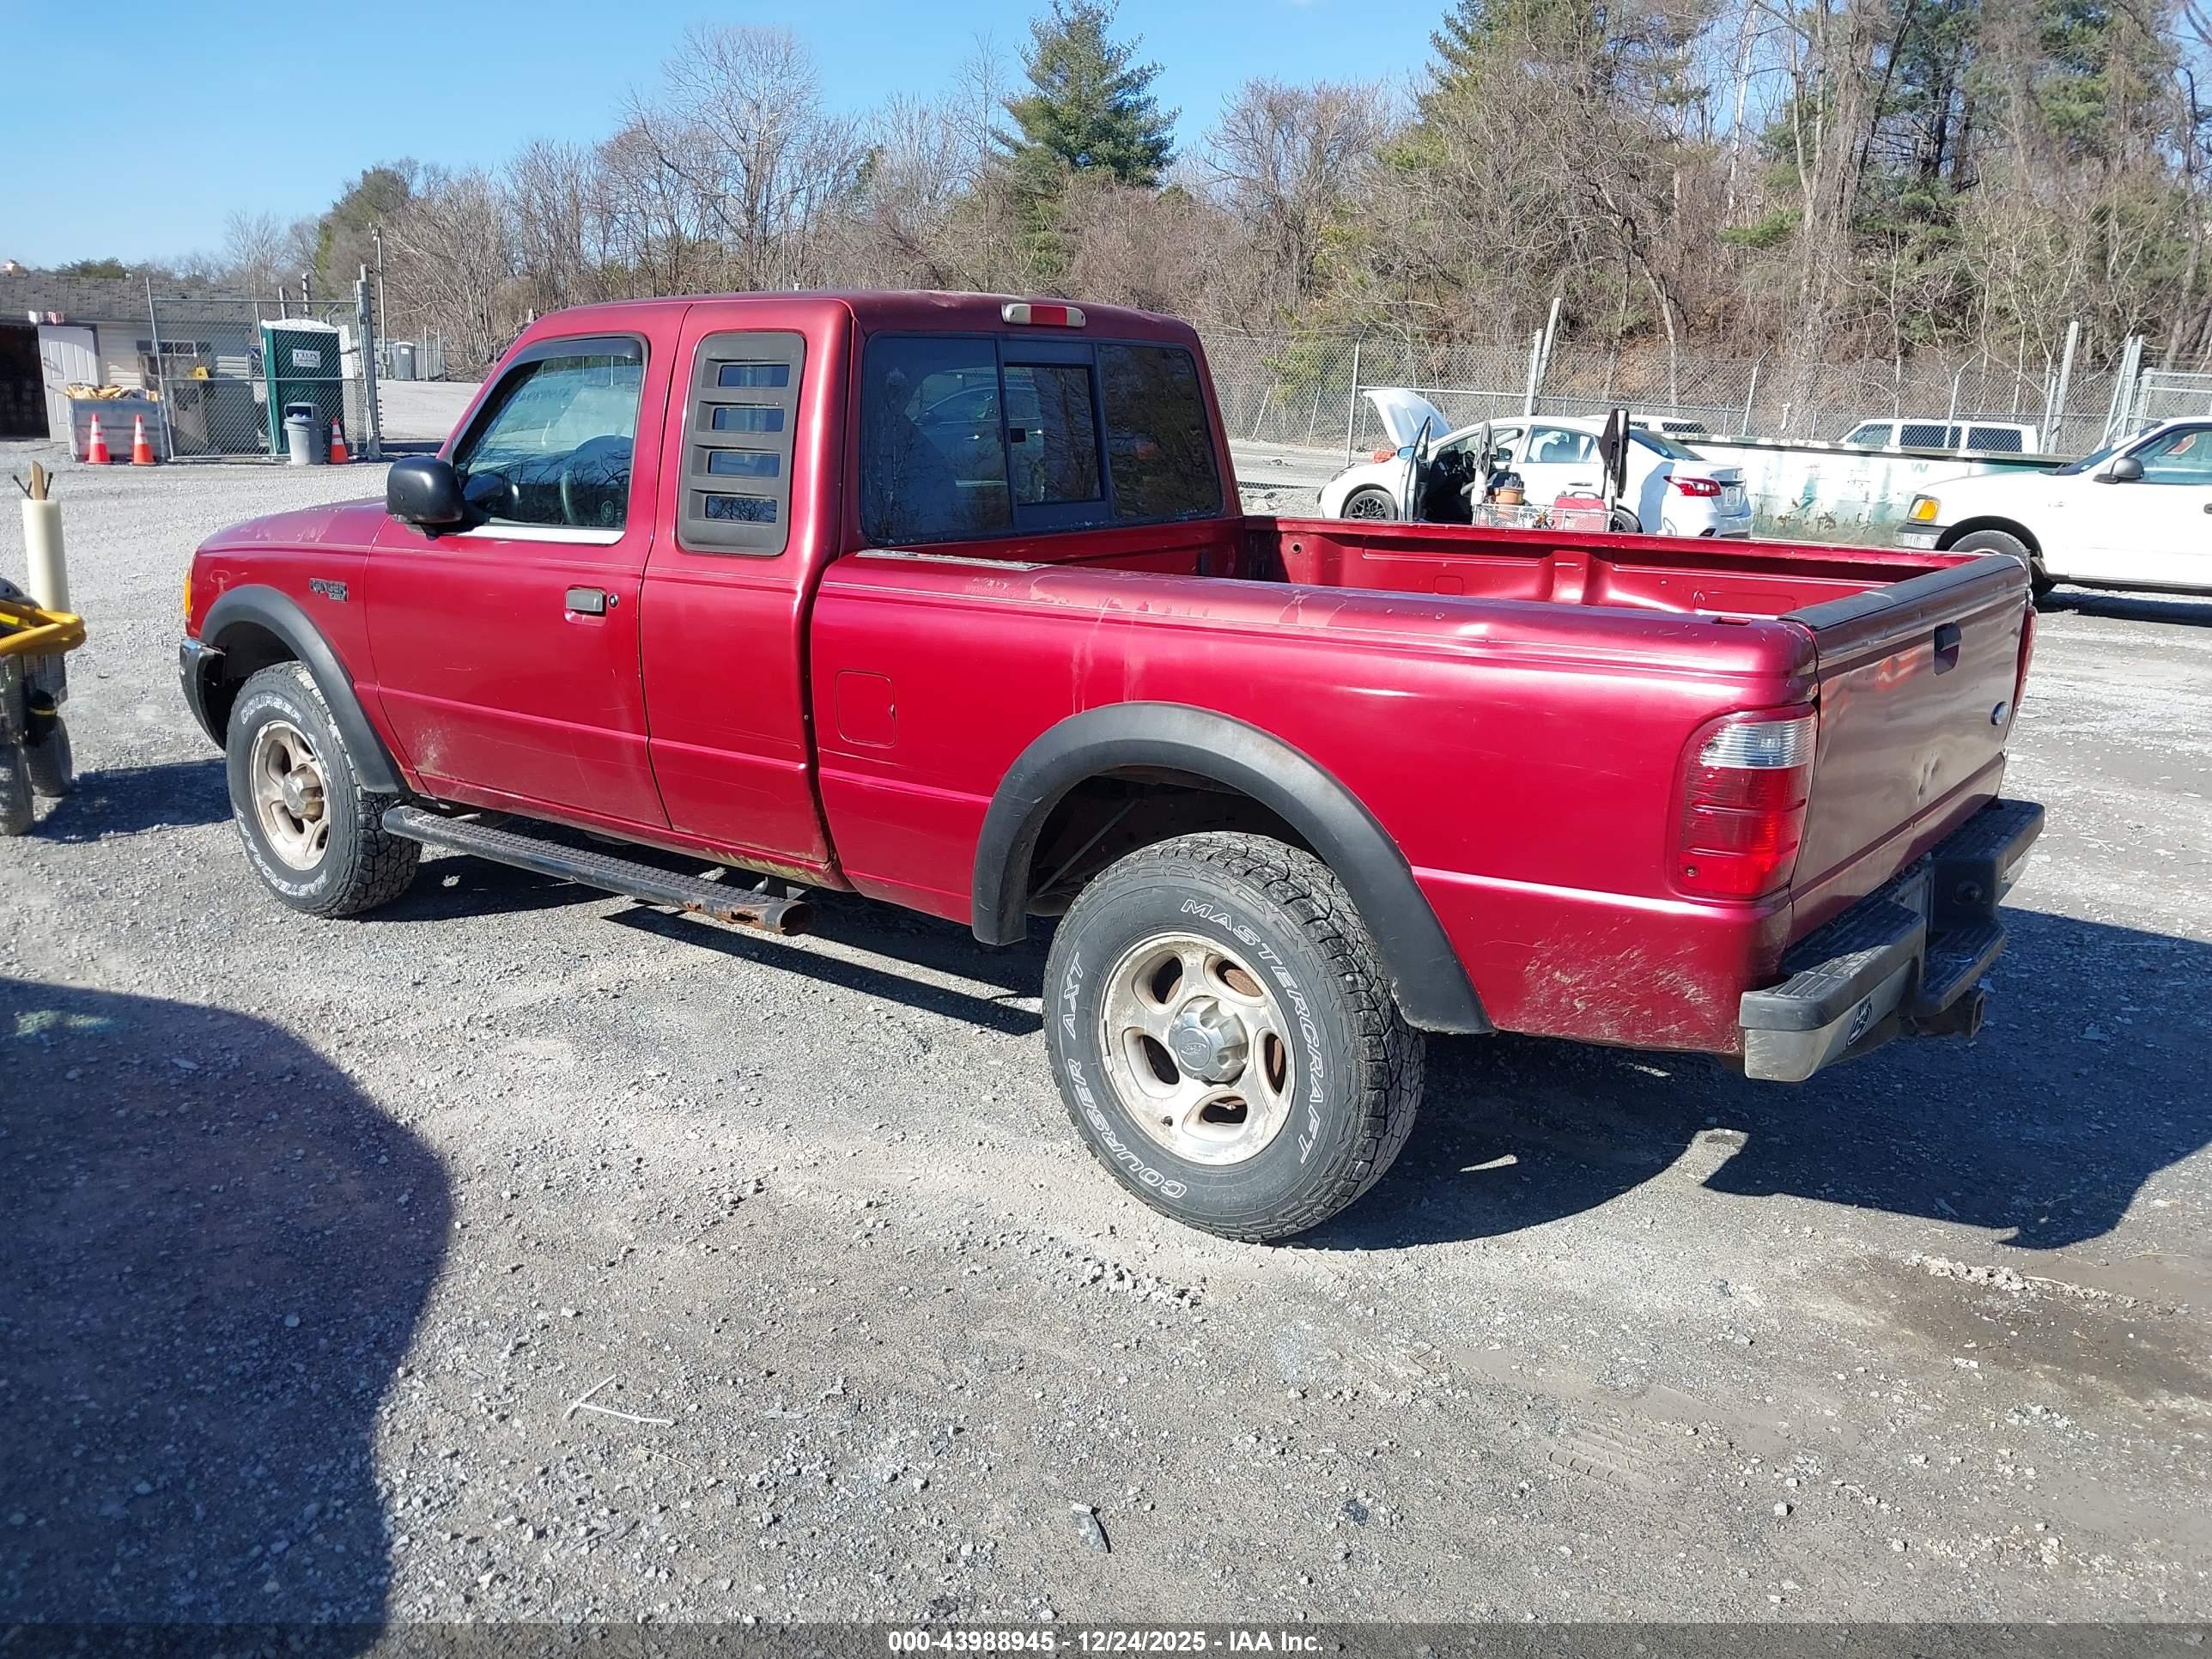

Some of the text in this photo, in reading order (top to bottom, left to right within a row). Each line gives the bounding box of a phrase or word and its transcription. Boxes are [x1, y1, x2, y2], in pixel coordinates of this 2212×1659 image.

[241, 696, 302, 725] COURSER
[234, 804, 326, 896] MASTERCRAFT
[1062, 951, 1188, 1199] COURSER AXT
[1180, 898, 1324, 1164] MASTERCRAFT
